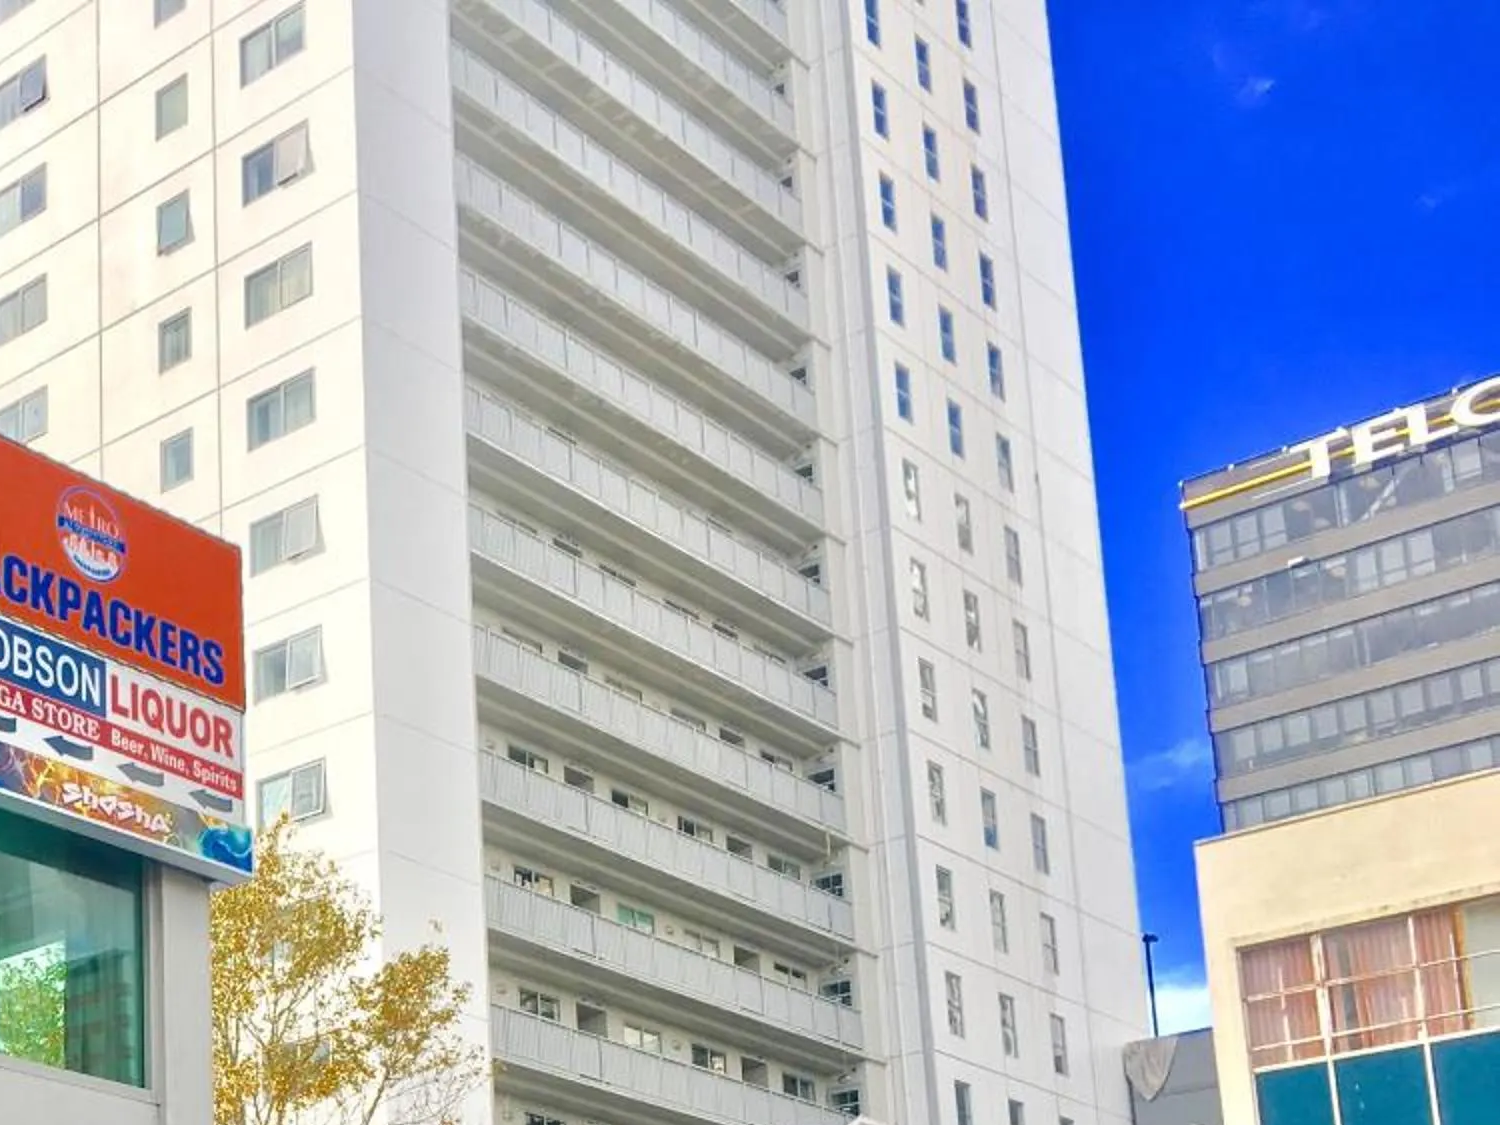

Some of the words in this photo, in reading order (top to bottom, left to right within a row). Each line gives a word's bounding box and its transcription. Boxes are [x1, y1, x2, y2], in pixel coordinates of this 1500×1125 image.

[31, 697, 101, 742] STORE
[193, 760, 238, 792] Spirits
[110, 673, 234, 760] LIQUOR
